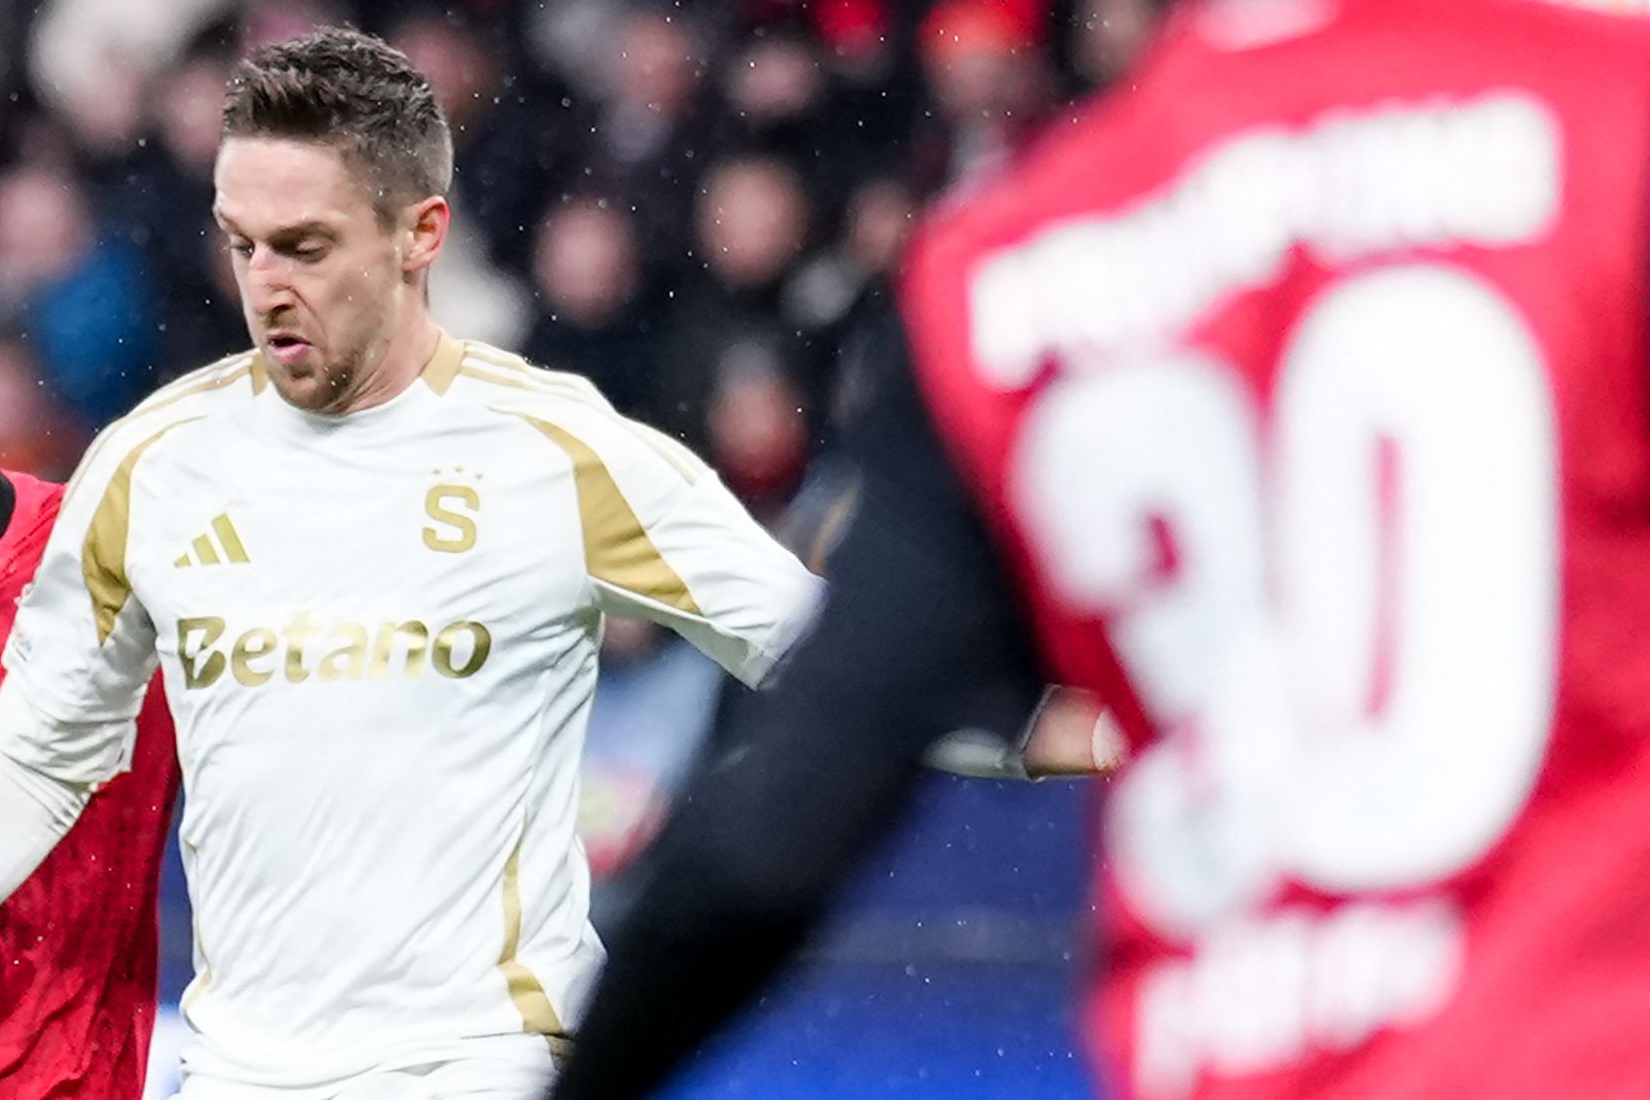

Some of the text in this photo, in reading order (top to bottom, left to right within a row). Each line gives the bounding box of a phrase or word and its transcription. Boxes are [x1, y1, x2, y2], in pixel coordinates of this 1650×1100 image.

[422, 484, 480, 553] S
[1014, 262, 1562, 938] 30
[176, 612, 492, 690] Betano
